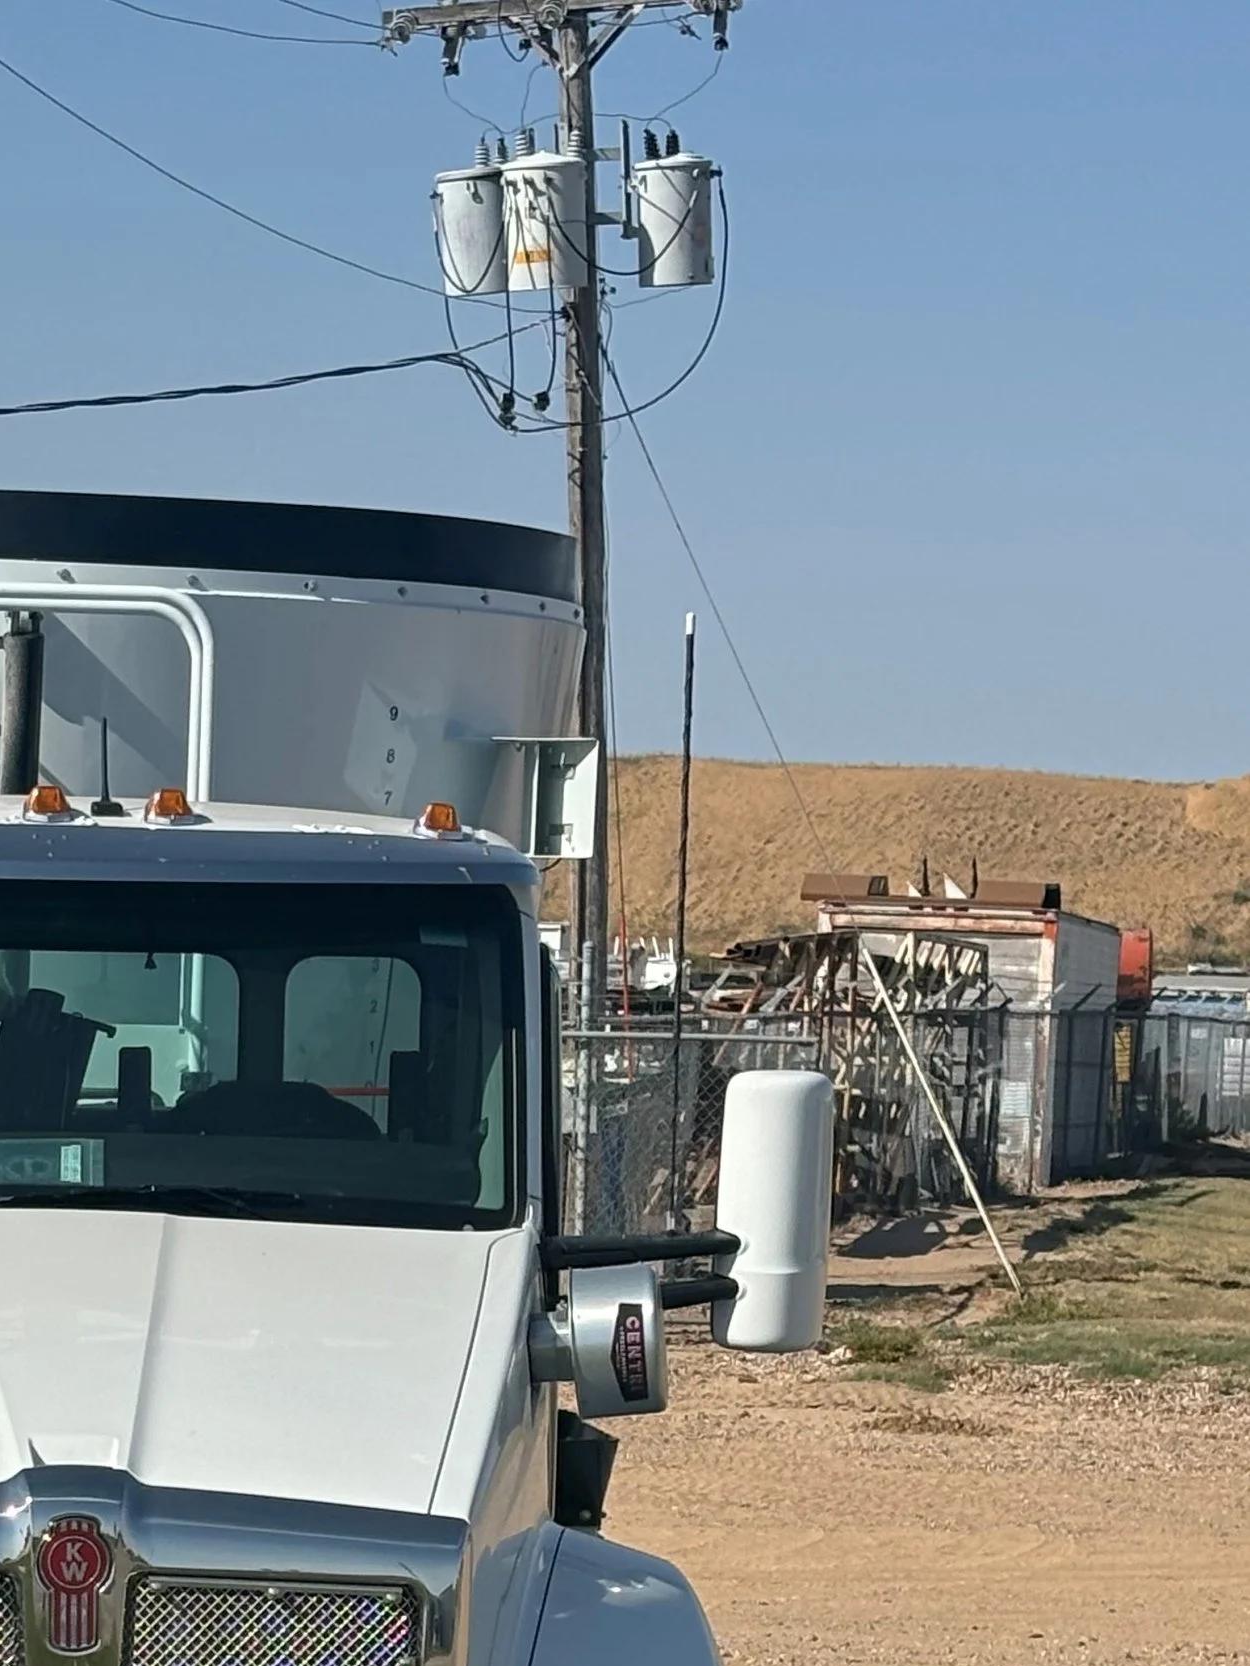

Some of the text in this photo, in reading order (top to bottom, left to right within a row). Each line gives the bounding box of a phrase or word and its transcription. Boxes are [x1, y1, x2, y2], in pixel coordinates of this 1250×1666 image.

[389, 705, 399, 721] 9
[386, 748, 396, 764] 8
[384, 790, 393, 806] 7
[369, 999, 378, 1014] 2
[625, 1315, 645, 1391] CENTRI
